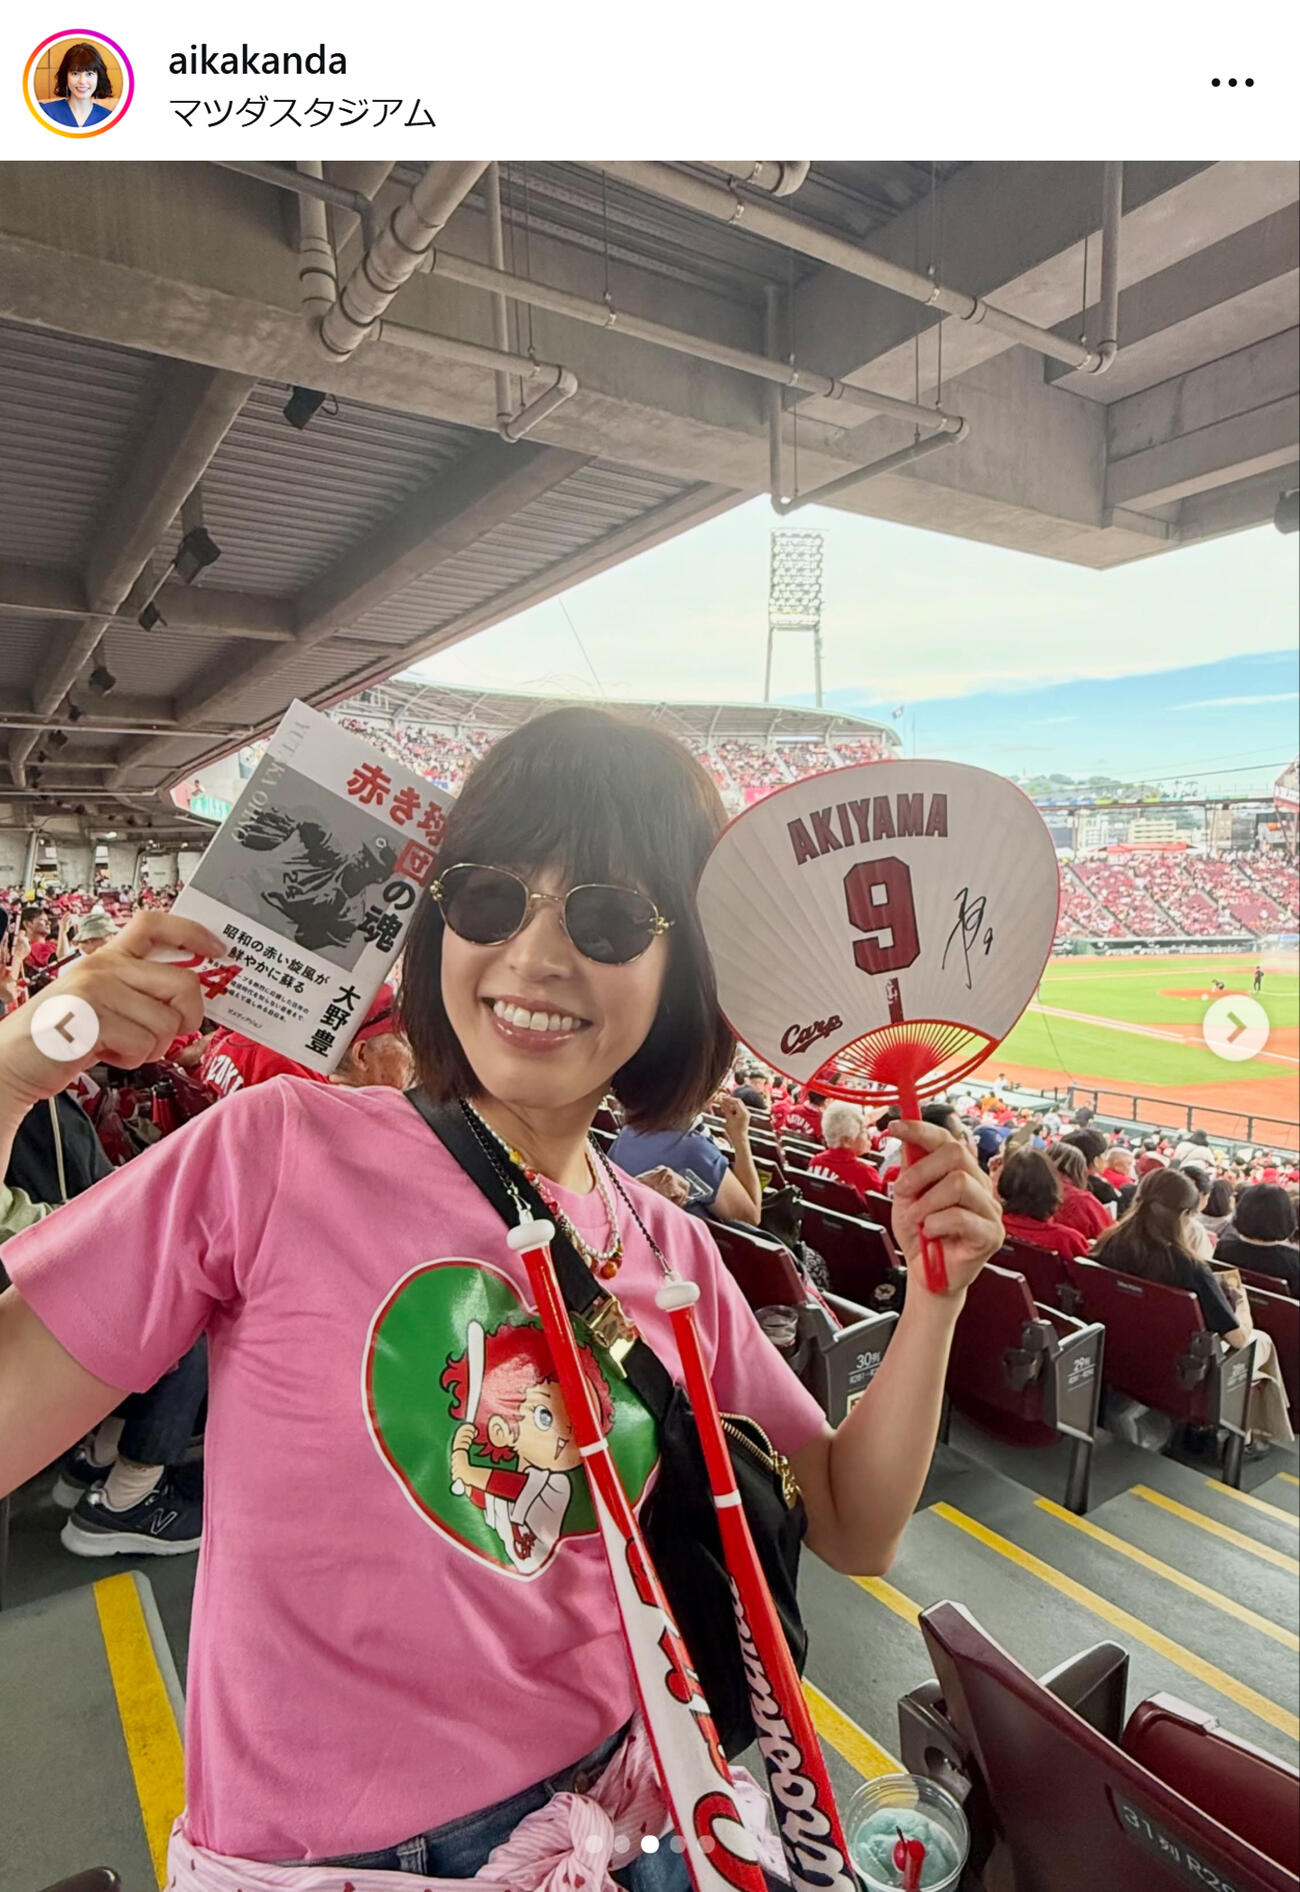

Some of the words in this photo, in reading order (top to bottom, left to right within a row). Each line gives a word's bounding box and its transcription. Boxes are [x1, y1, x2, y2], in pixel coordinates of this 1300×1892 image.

[231, 790, 269, 842] OHNO
[786, 793, 948, 865] AKIYAMA
[843, 856, 921, 975] 9
[223, 923, 331, 985] 昭和の赤い旋風が
[228, 946, 304, 994] 鮮やかに蘇る
[305, 984, 362, 1058] 大野豊
[780, 1013, 844, 1056] Carp
